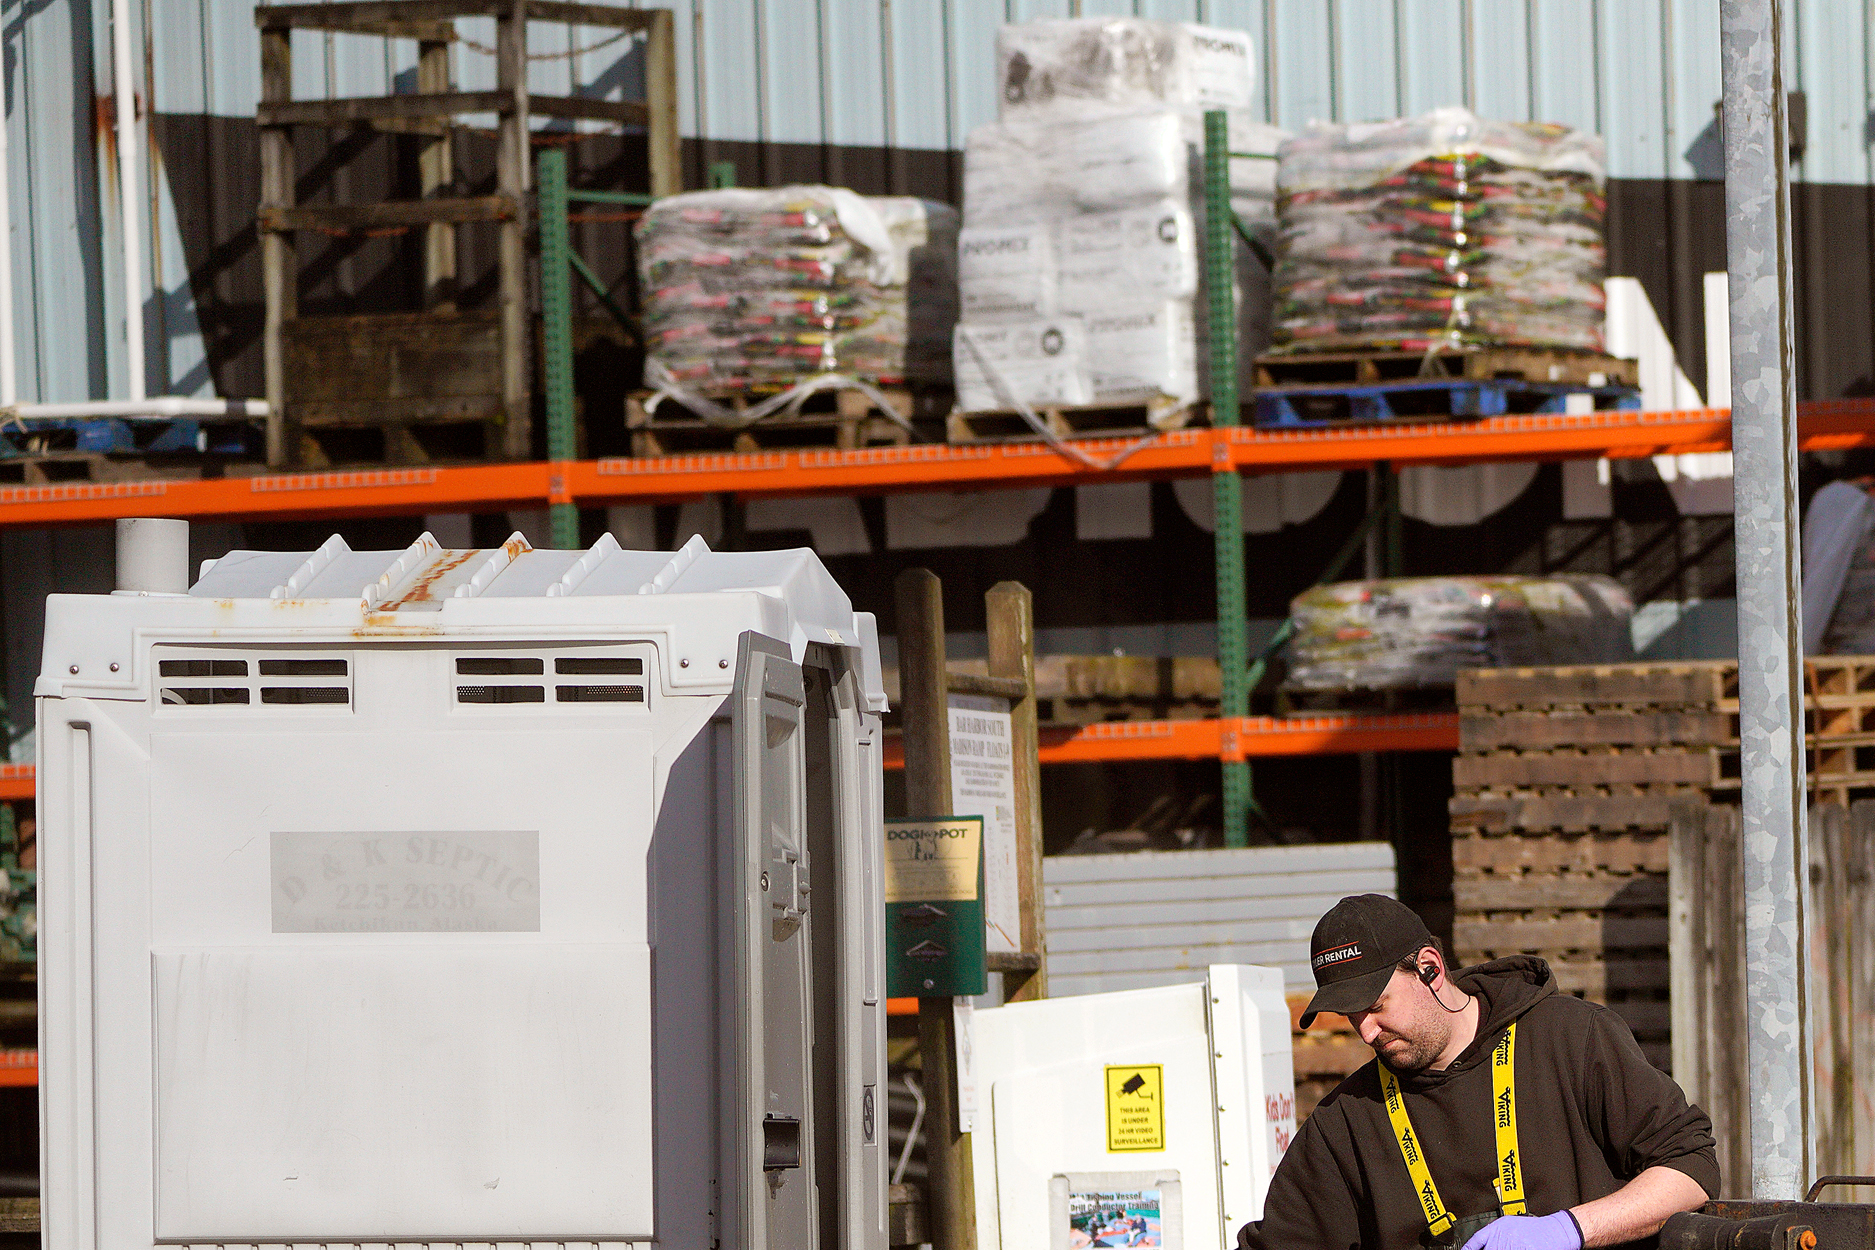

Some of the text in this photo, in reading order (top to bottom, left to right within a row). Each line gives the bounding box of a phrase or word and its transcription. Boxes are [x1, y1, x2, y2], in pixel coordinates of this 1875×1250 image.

[280, 836, 534, 905] D & K SEPTIC
[335, 882, 477, 911] 225-2636
[1324, 945, 1362, 964] RENTAL
[1114, 1137, 1158, 1145] SURVEILLANCE
[1402, 1129, 1418, 1166] VIKING
[1502, 1152, 1514, 1192] VIKING
[1116, 1191, 1142, 1200] Vessel
[1422, 1182, 1437, 1220] VIKING
